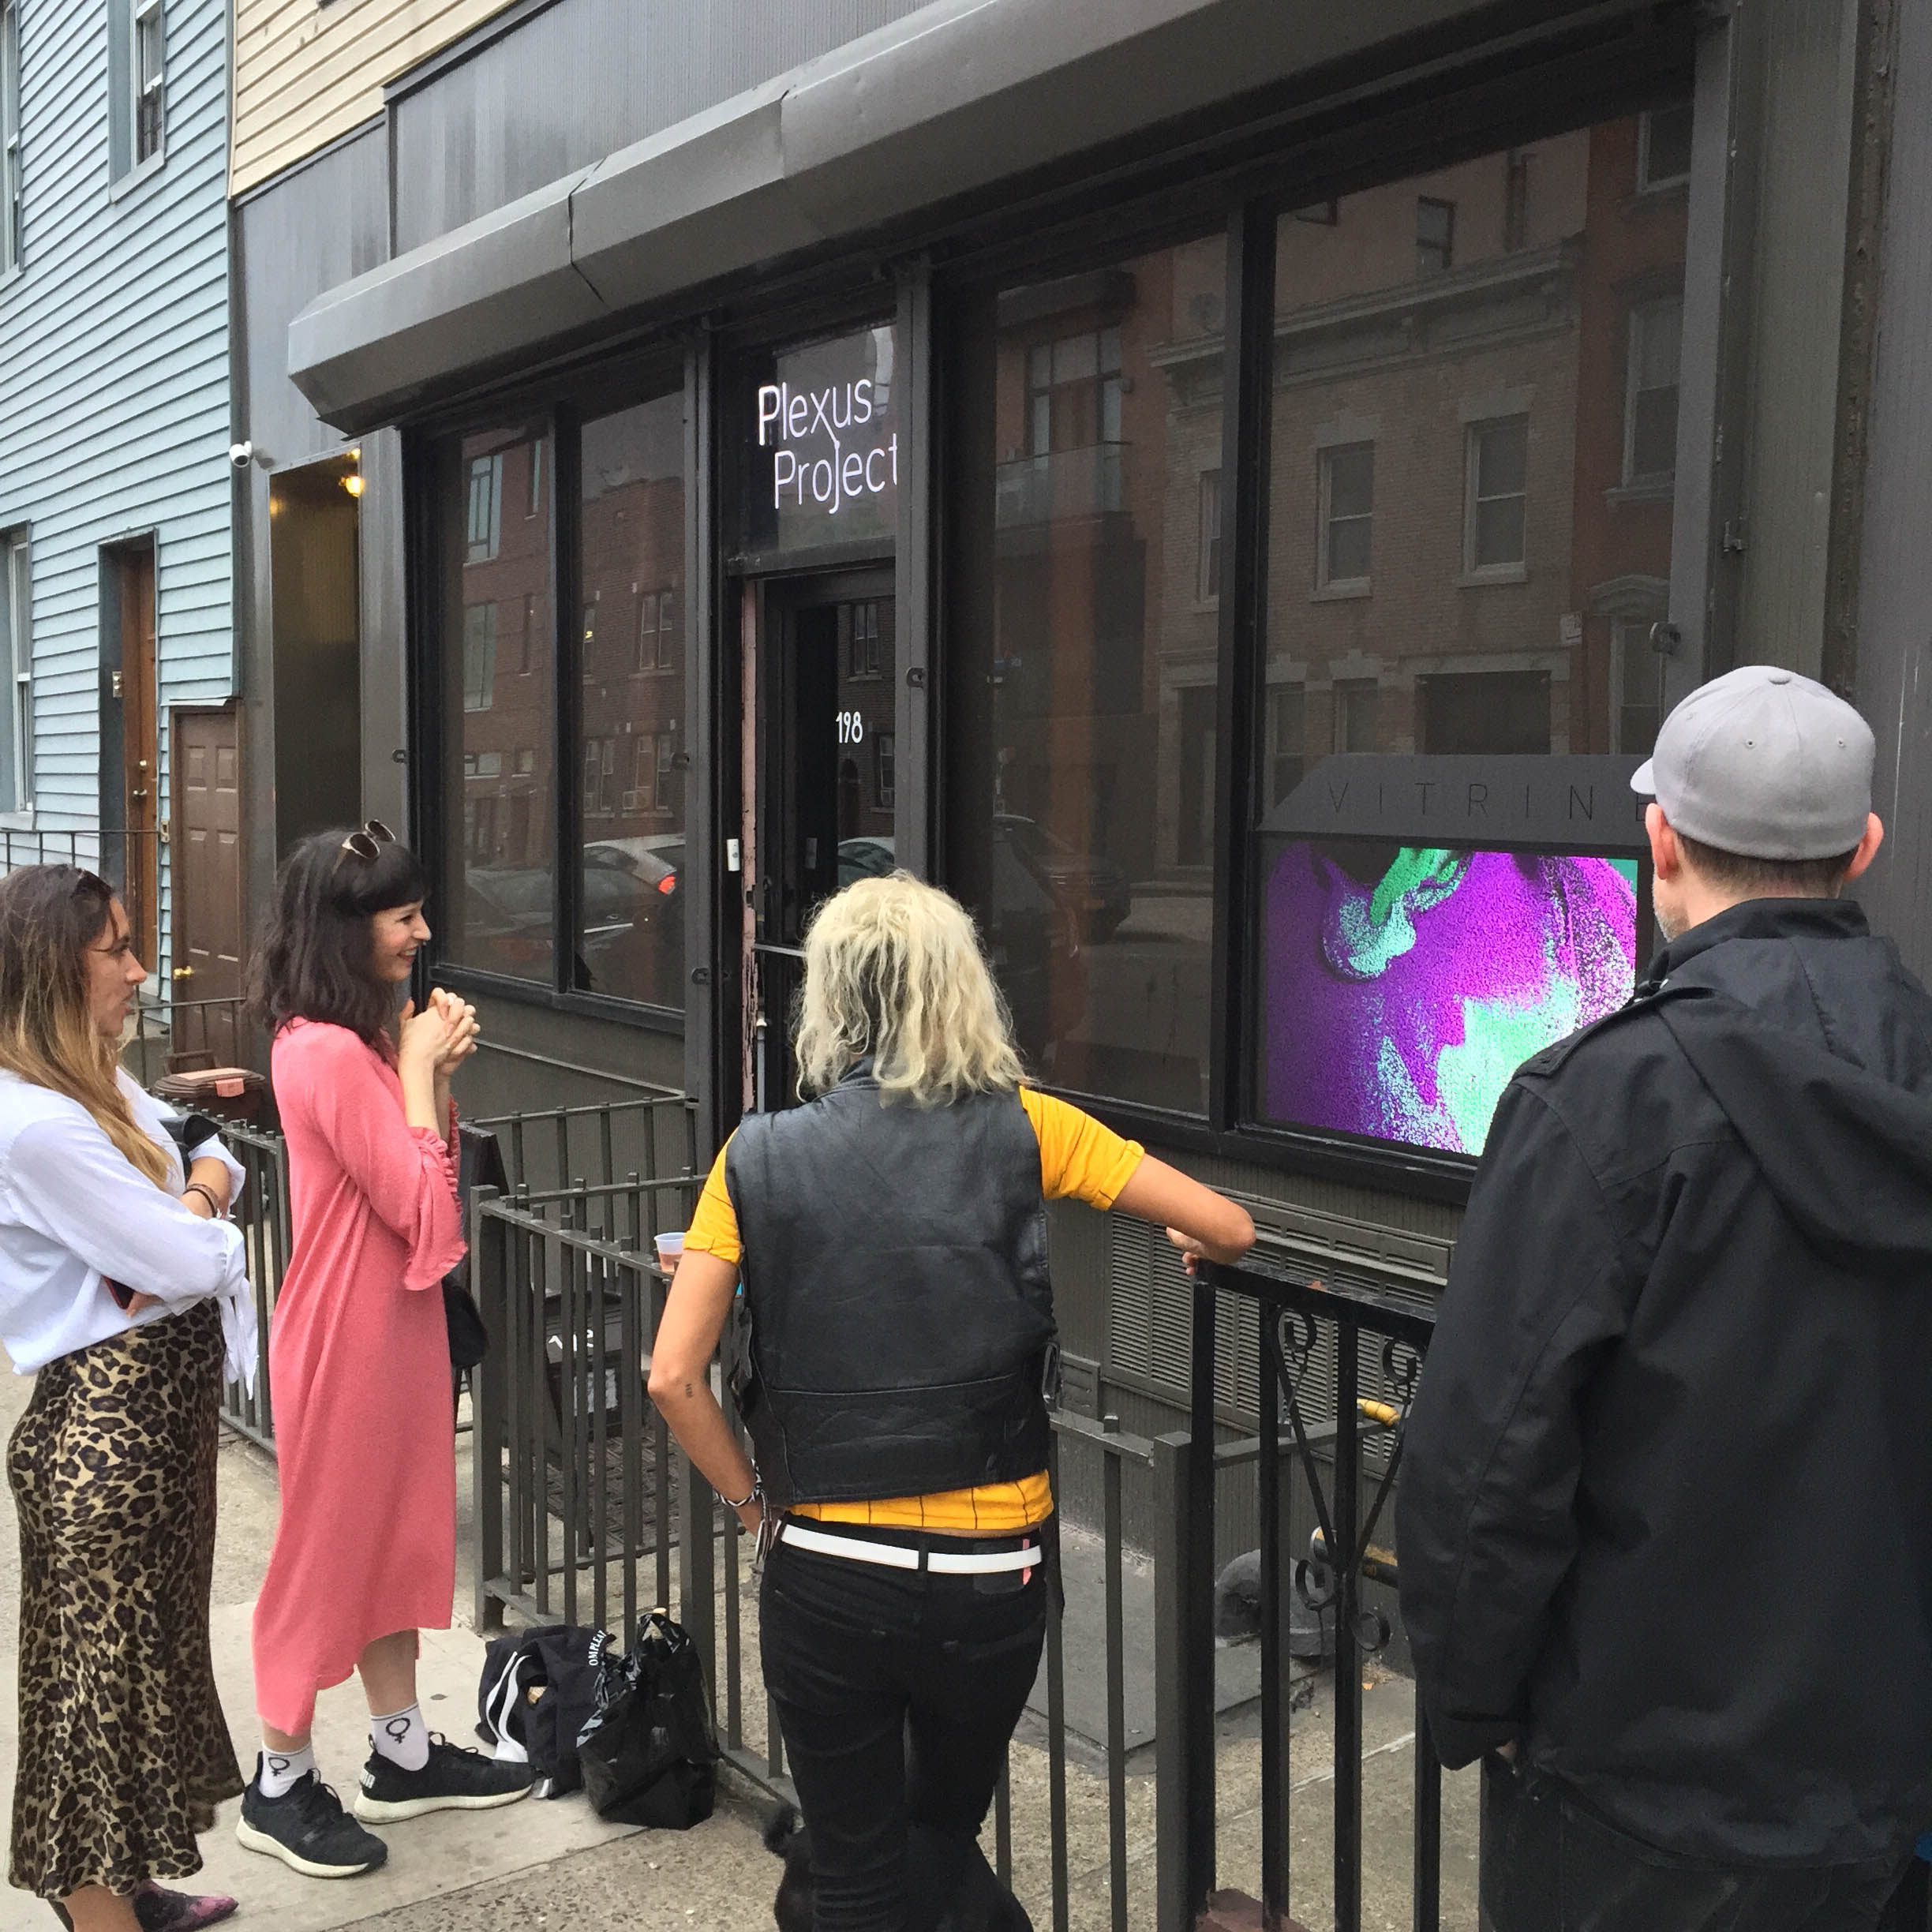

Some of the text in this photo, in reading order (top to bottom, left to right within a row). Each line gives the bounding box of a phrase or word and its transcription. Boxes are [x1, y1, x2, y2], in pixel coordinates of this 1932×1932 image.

[758, 379, 872, 447] Plexus
[774, 433, 897, 515] Project
[836, 711, 863, 743] 198
